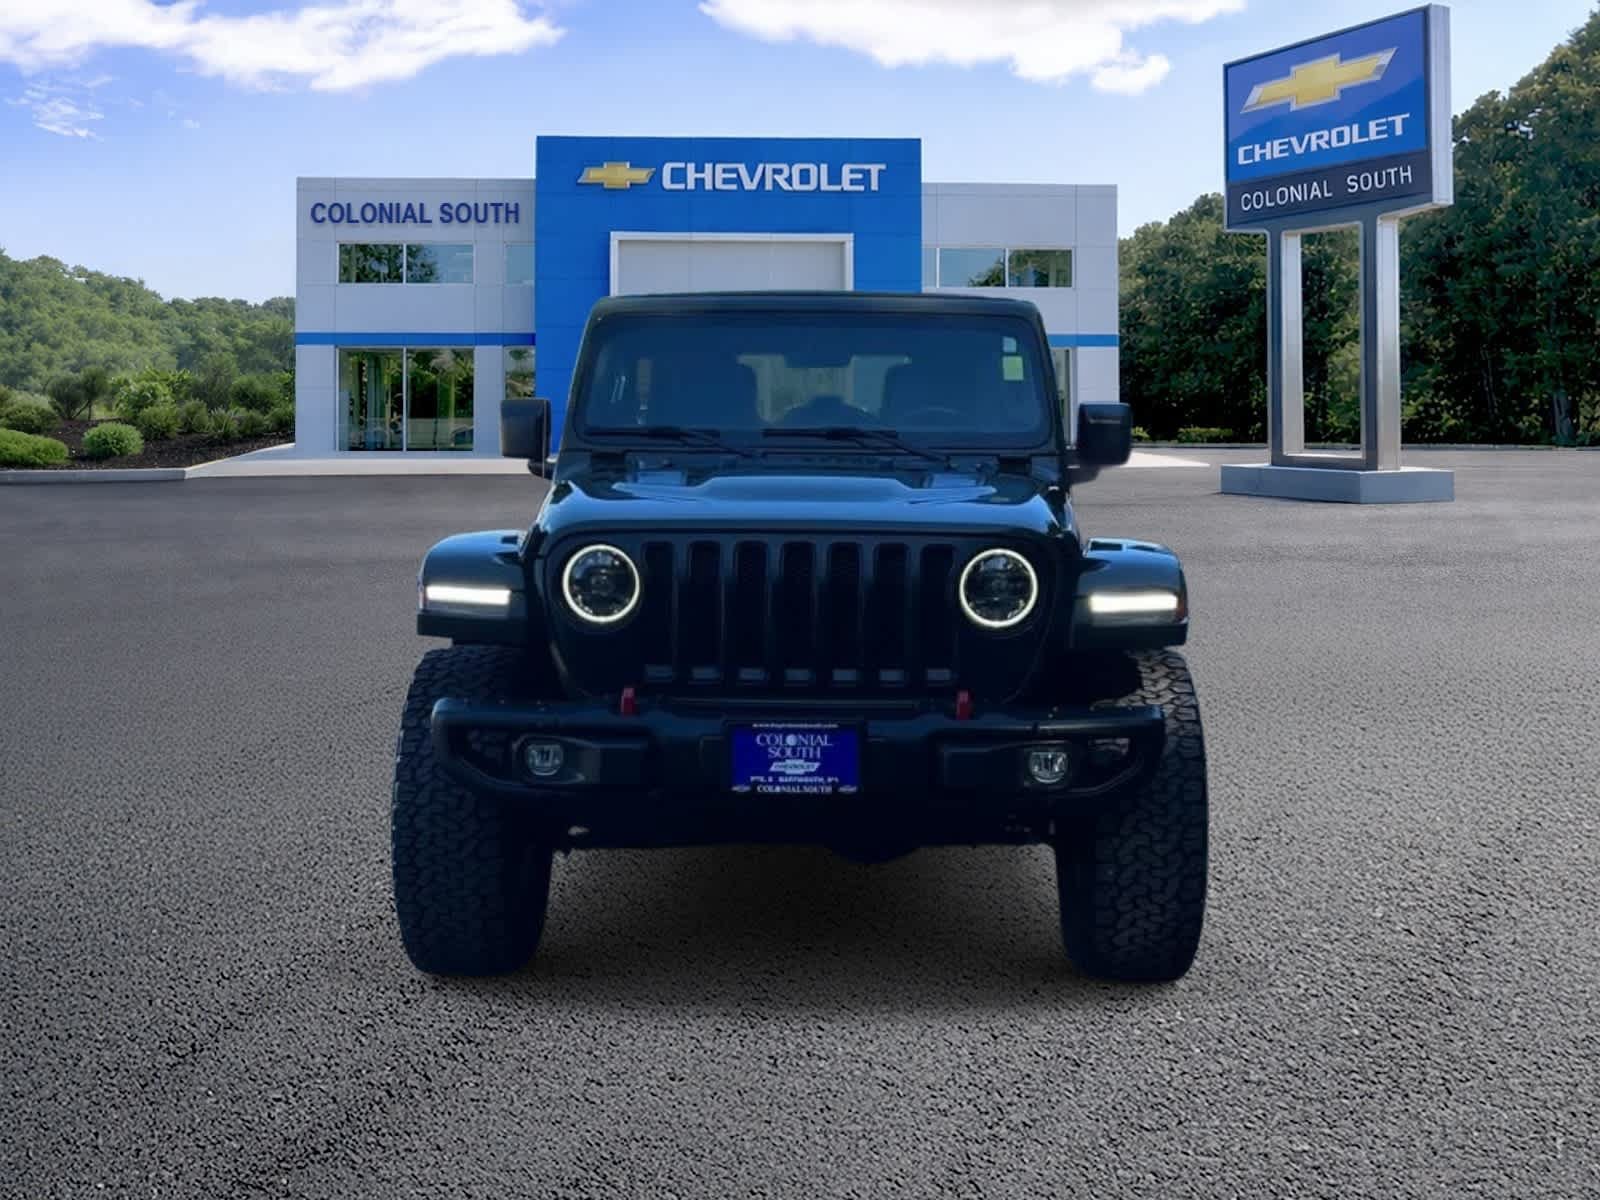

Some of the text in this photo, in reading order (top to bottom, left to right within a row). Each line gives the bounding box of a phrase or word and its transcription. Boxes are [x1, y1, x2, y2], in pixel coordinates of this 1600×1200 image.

[1238, 113, 1410, 165] CHEVROLET
[662, 162, 886, 192] CHEVROLET
[1240, 165, 1413, 211] COLONIAL SOUTH
[310, 202, 520, 224] COLONIAL SOUTH
[756, 733, 833, 747] COLONIAL
[768, 746, 821, 759] SOUTH
